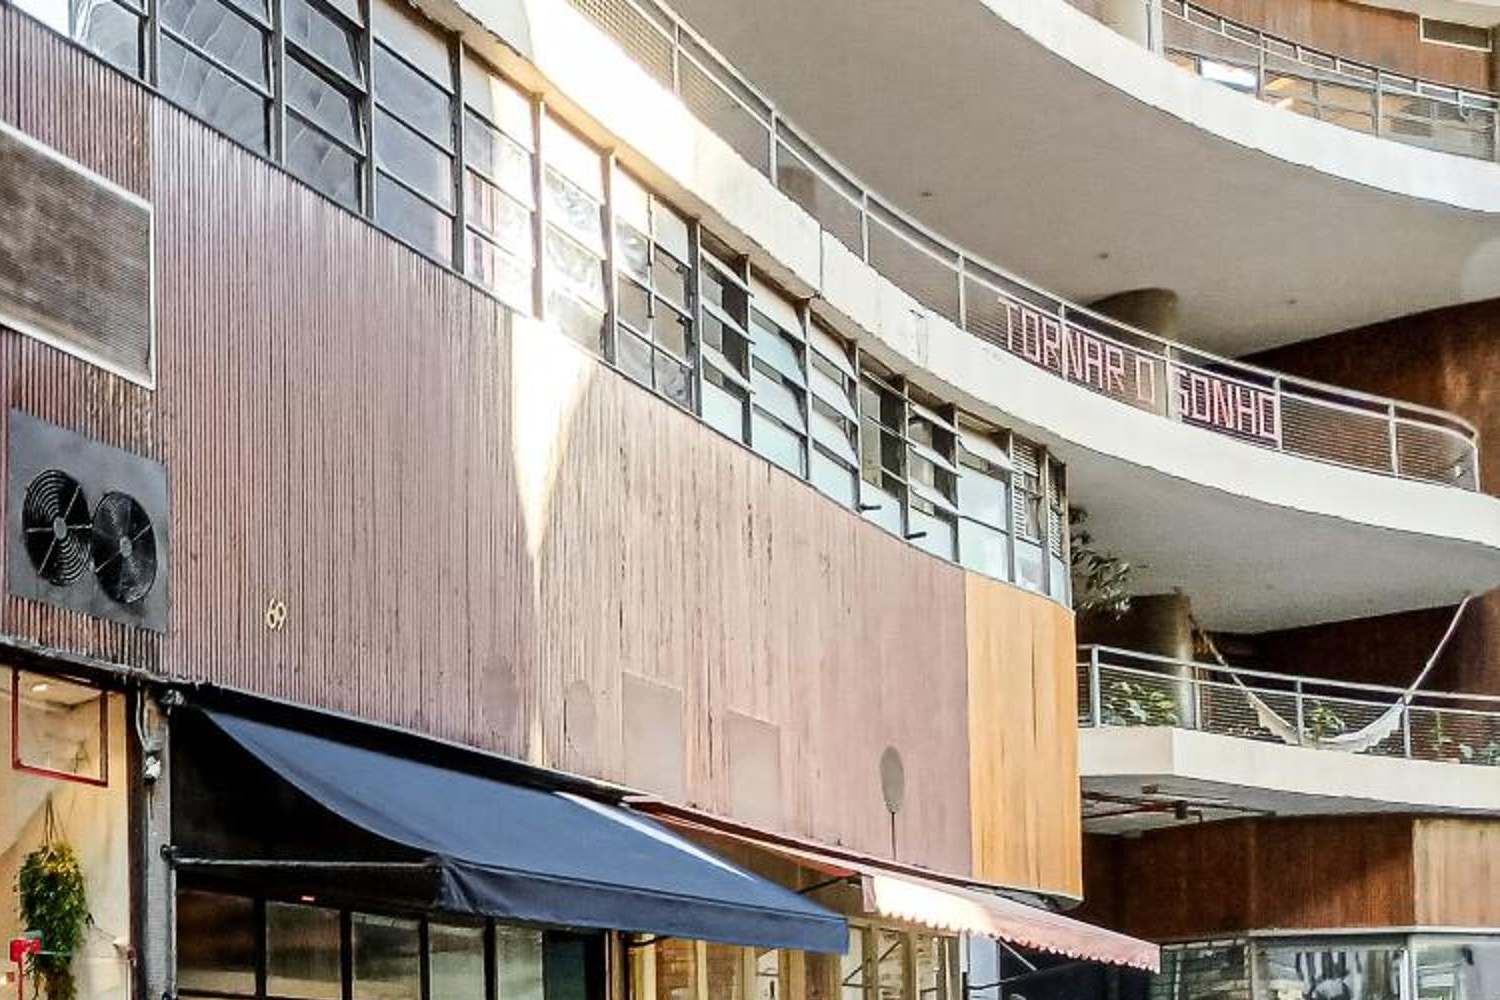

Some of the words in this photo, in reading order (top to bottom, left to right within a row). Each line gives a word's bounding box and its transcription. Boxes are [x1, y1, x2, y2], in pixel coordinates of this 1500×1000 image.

[998, 297, 1125, 391] TORNAR
[1135, 355, 1155, 406] O
[1172, 365, 1280, 440] SONHO
[267, 598, 287, 631] 69
